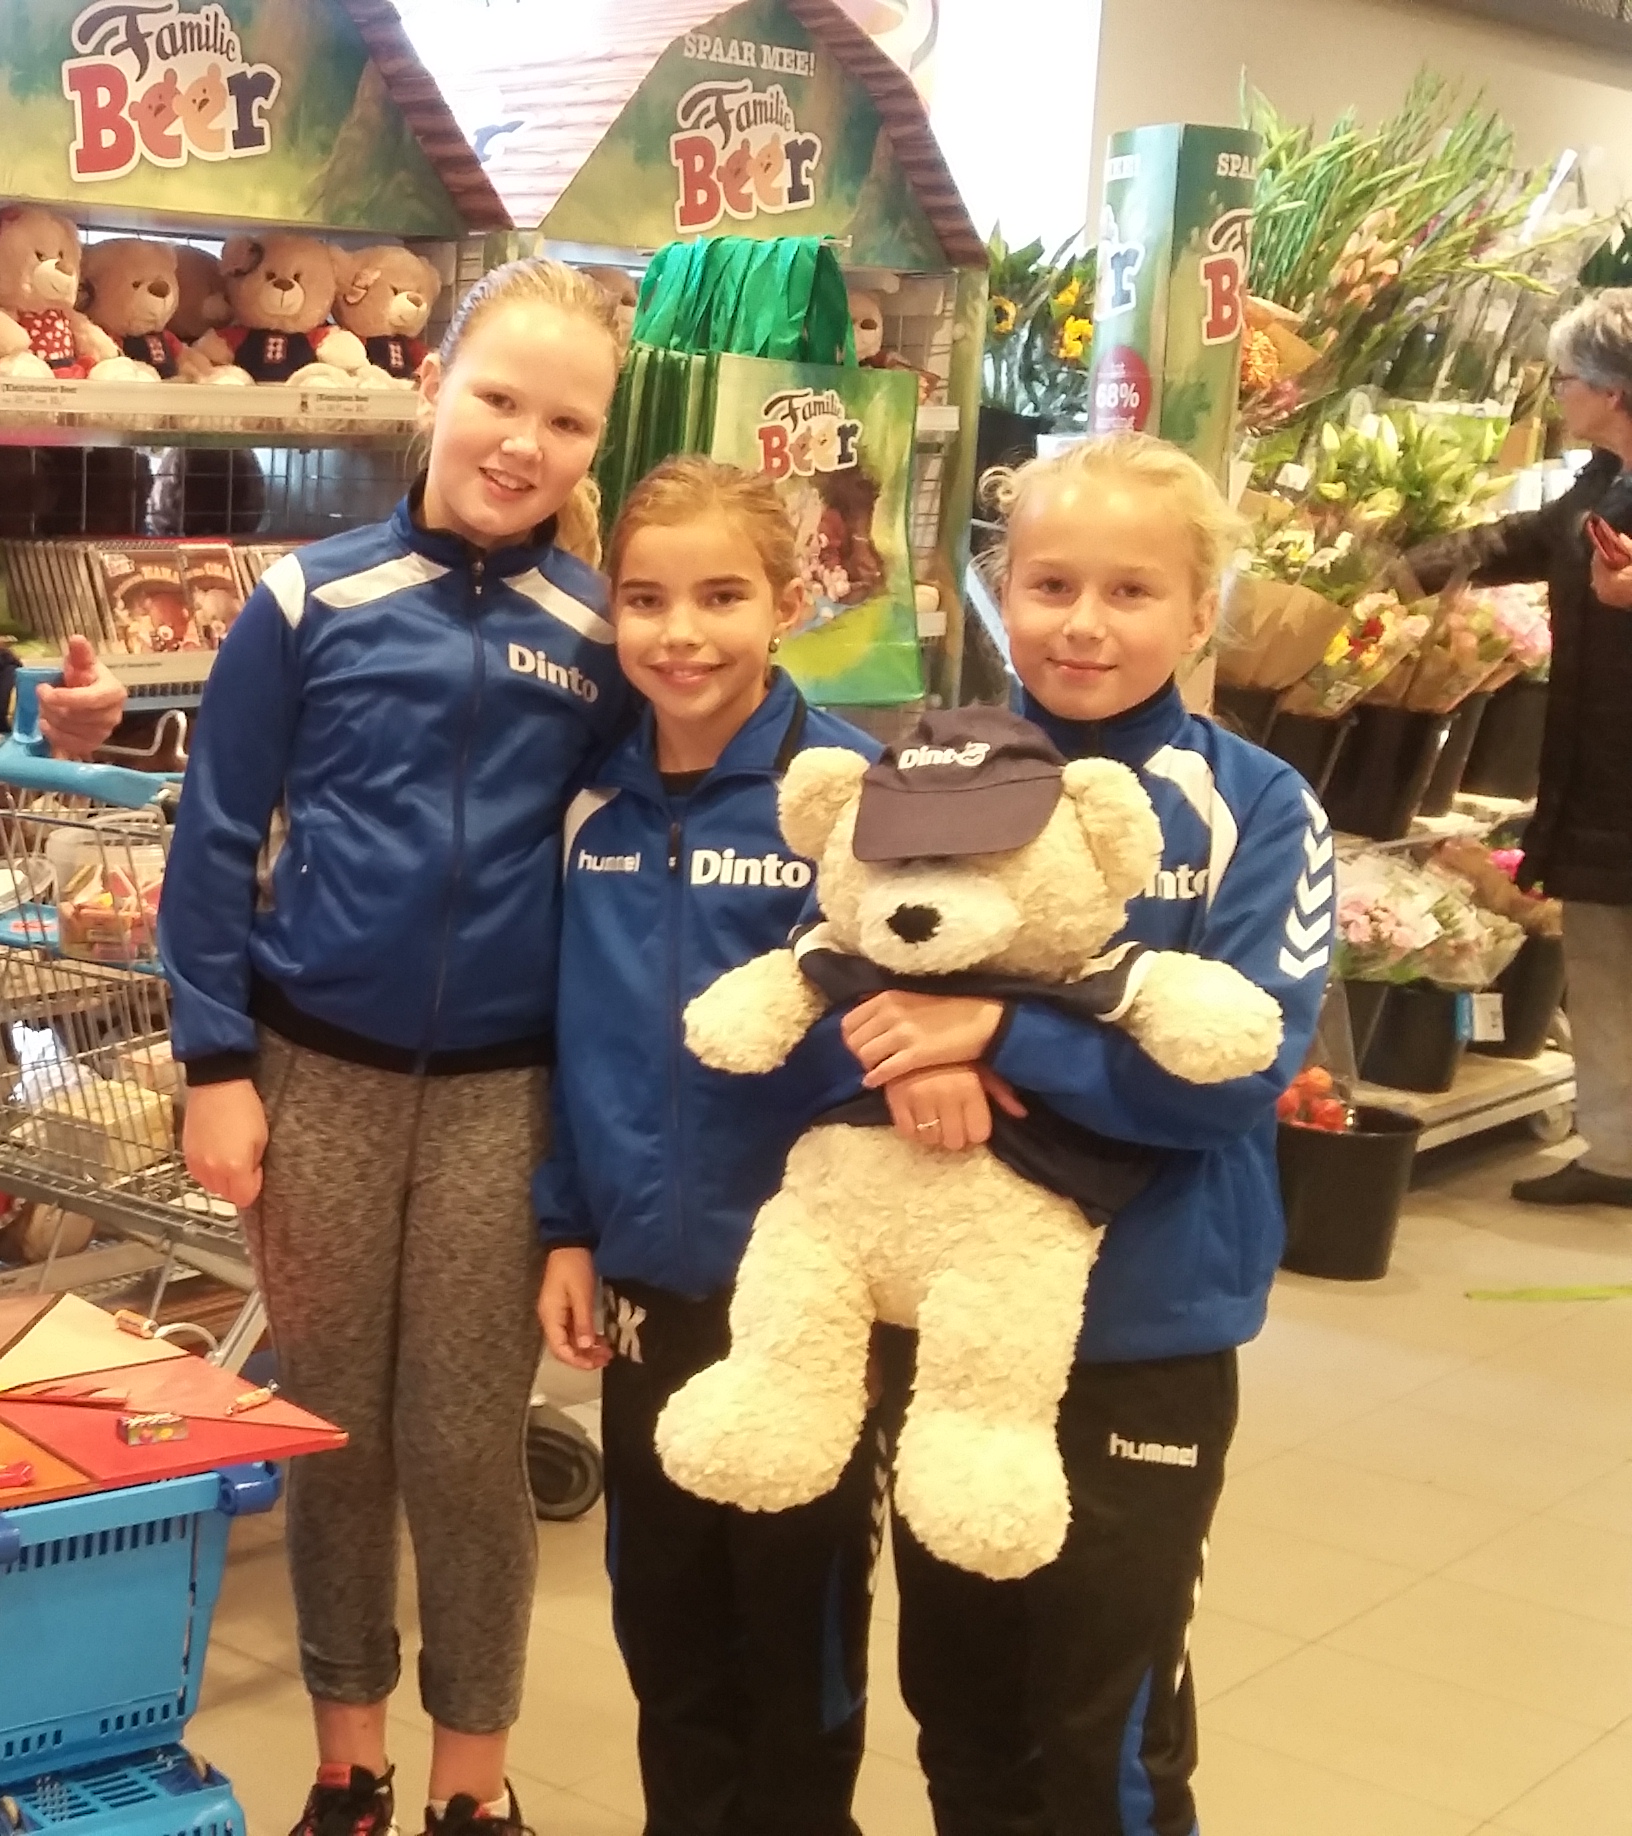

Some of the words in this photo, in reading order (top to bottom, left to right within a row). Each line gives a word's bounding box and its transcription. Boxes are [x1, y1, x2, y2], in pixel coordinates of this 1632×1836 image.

[77, 4, 237, 83] Familie
[682, 33, 757, 68] SPAAR
[761, 44, 816, 77] MEE!
[68, 63, 276, 174] Beer
[681, 84, 792, 150] Familie
[674, 132, 818, 226] Beer
[758, 423, 860, 480] Beer
[508, 641, 599, 703] Dinto
[690, 848, 812, 889] Dinto
[1109, 1431, 1199, 1469] hummel
